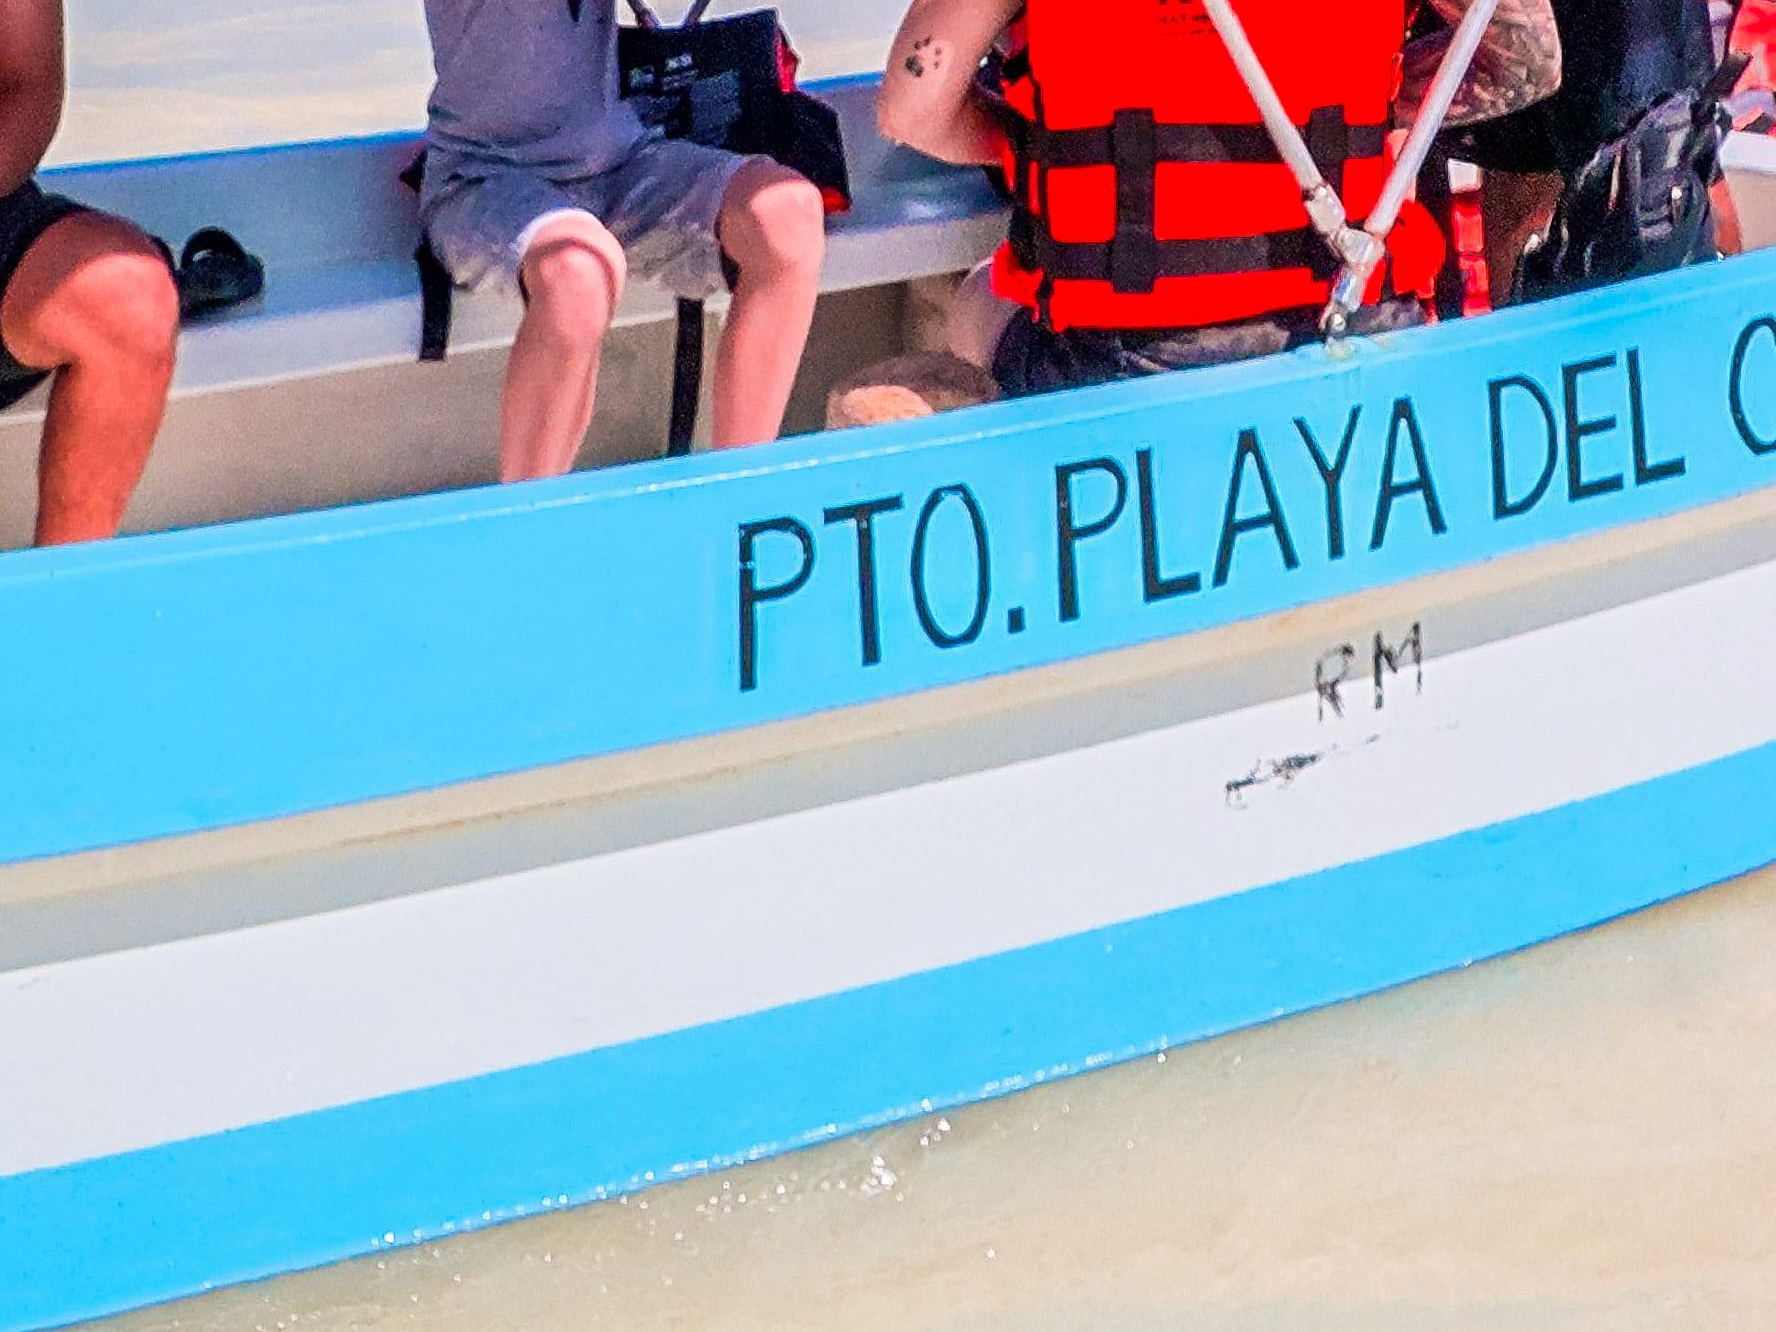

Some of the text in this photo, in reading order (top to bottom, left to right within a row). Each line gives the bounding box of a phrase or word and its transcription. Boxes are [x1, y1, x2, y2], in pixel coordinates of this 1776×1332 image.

[737, 482, 1026, 692] PTO.
[1053, 396, 1446, 621] PLAYA
[1488, 347, 1686, 520] DEL
